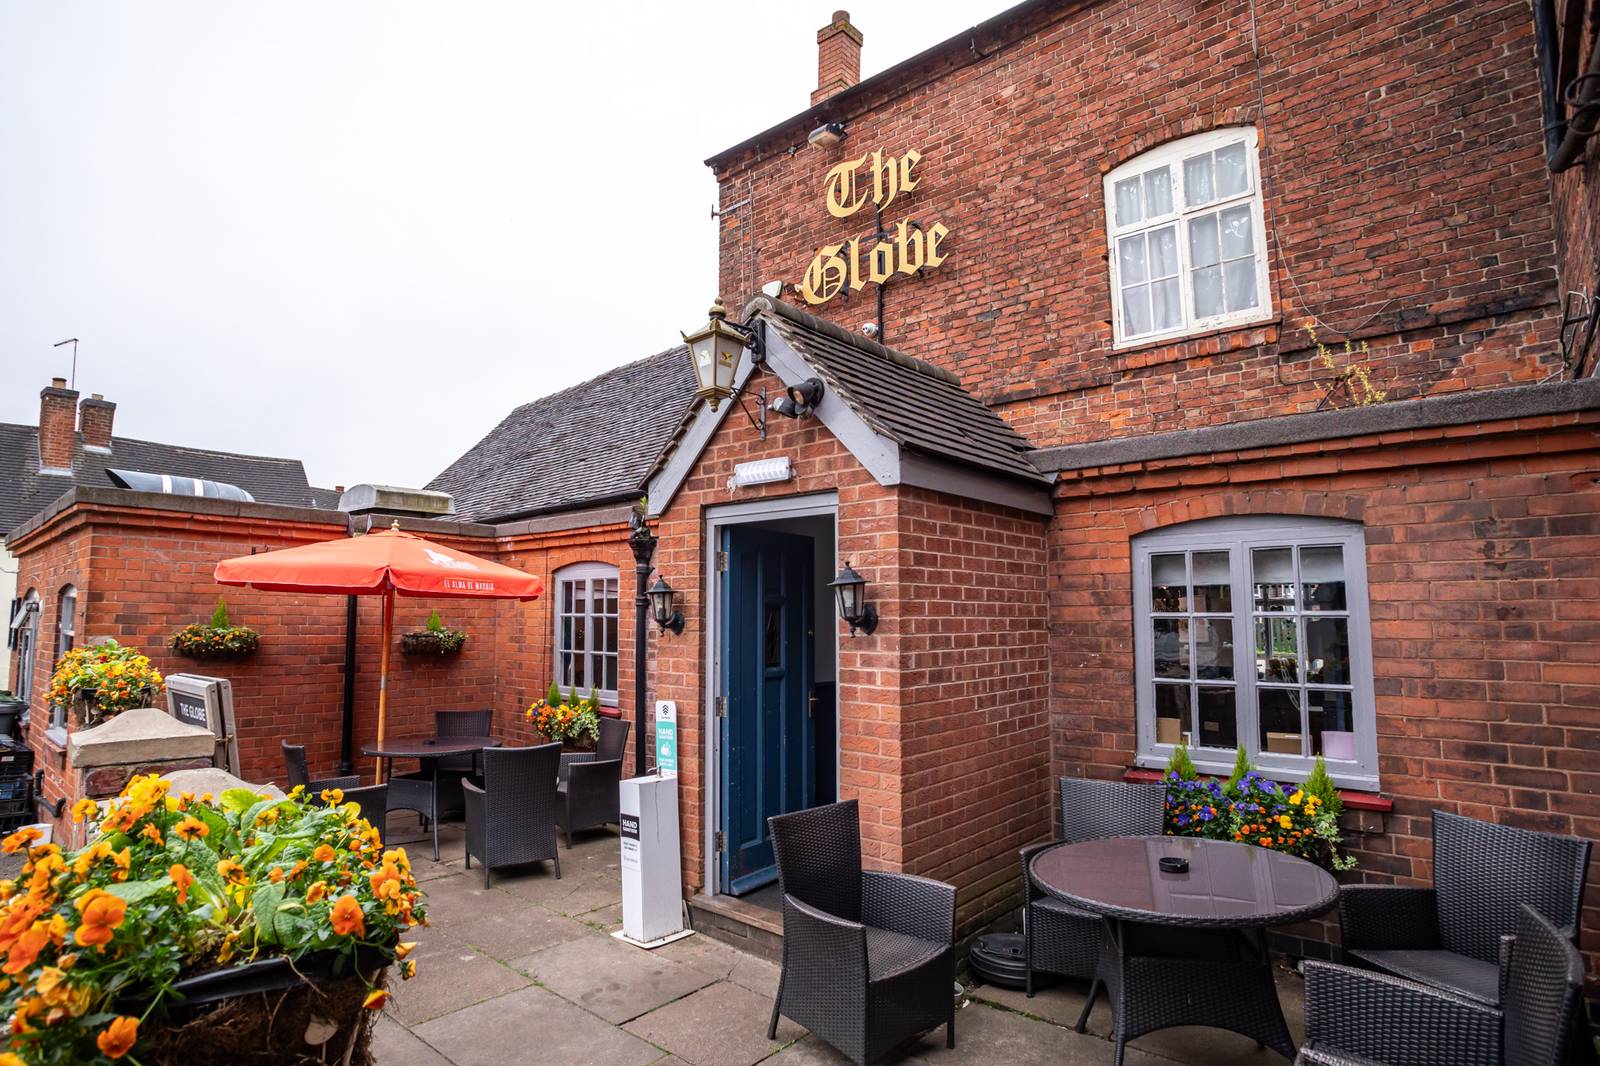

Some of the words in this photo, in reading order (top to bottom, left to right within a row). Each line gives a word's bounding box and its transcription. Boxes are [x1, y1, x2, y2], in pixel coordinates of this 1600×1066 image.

[823, 146, 922, 218] The
[803, 217, 950, 305] Globe
[444, 579, 450, 588] EL
[180, 703, 190, 717] THE
[189, 705, 206, 721] GLOBE
[658, 728, 674, 736] HAND
[622, 819, 638, 829] HAND
